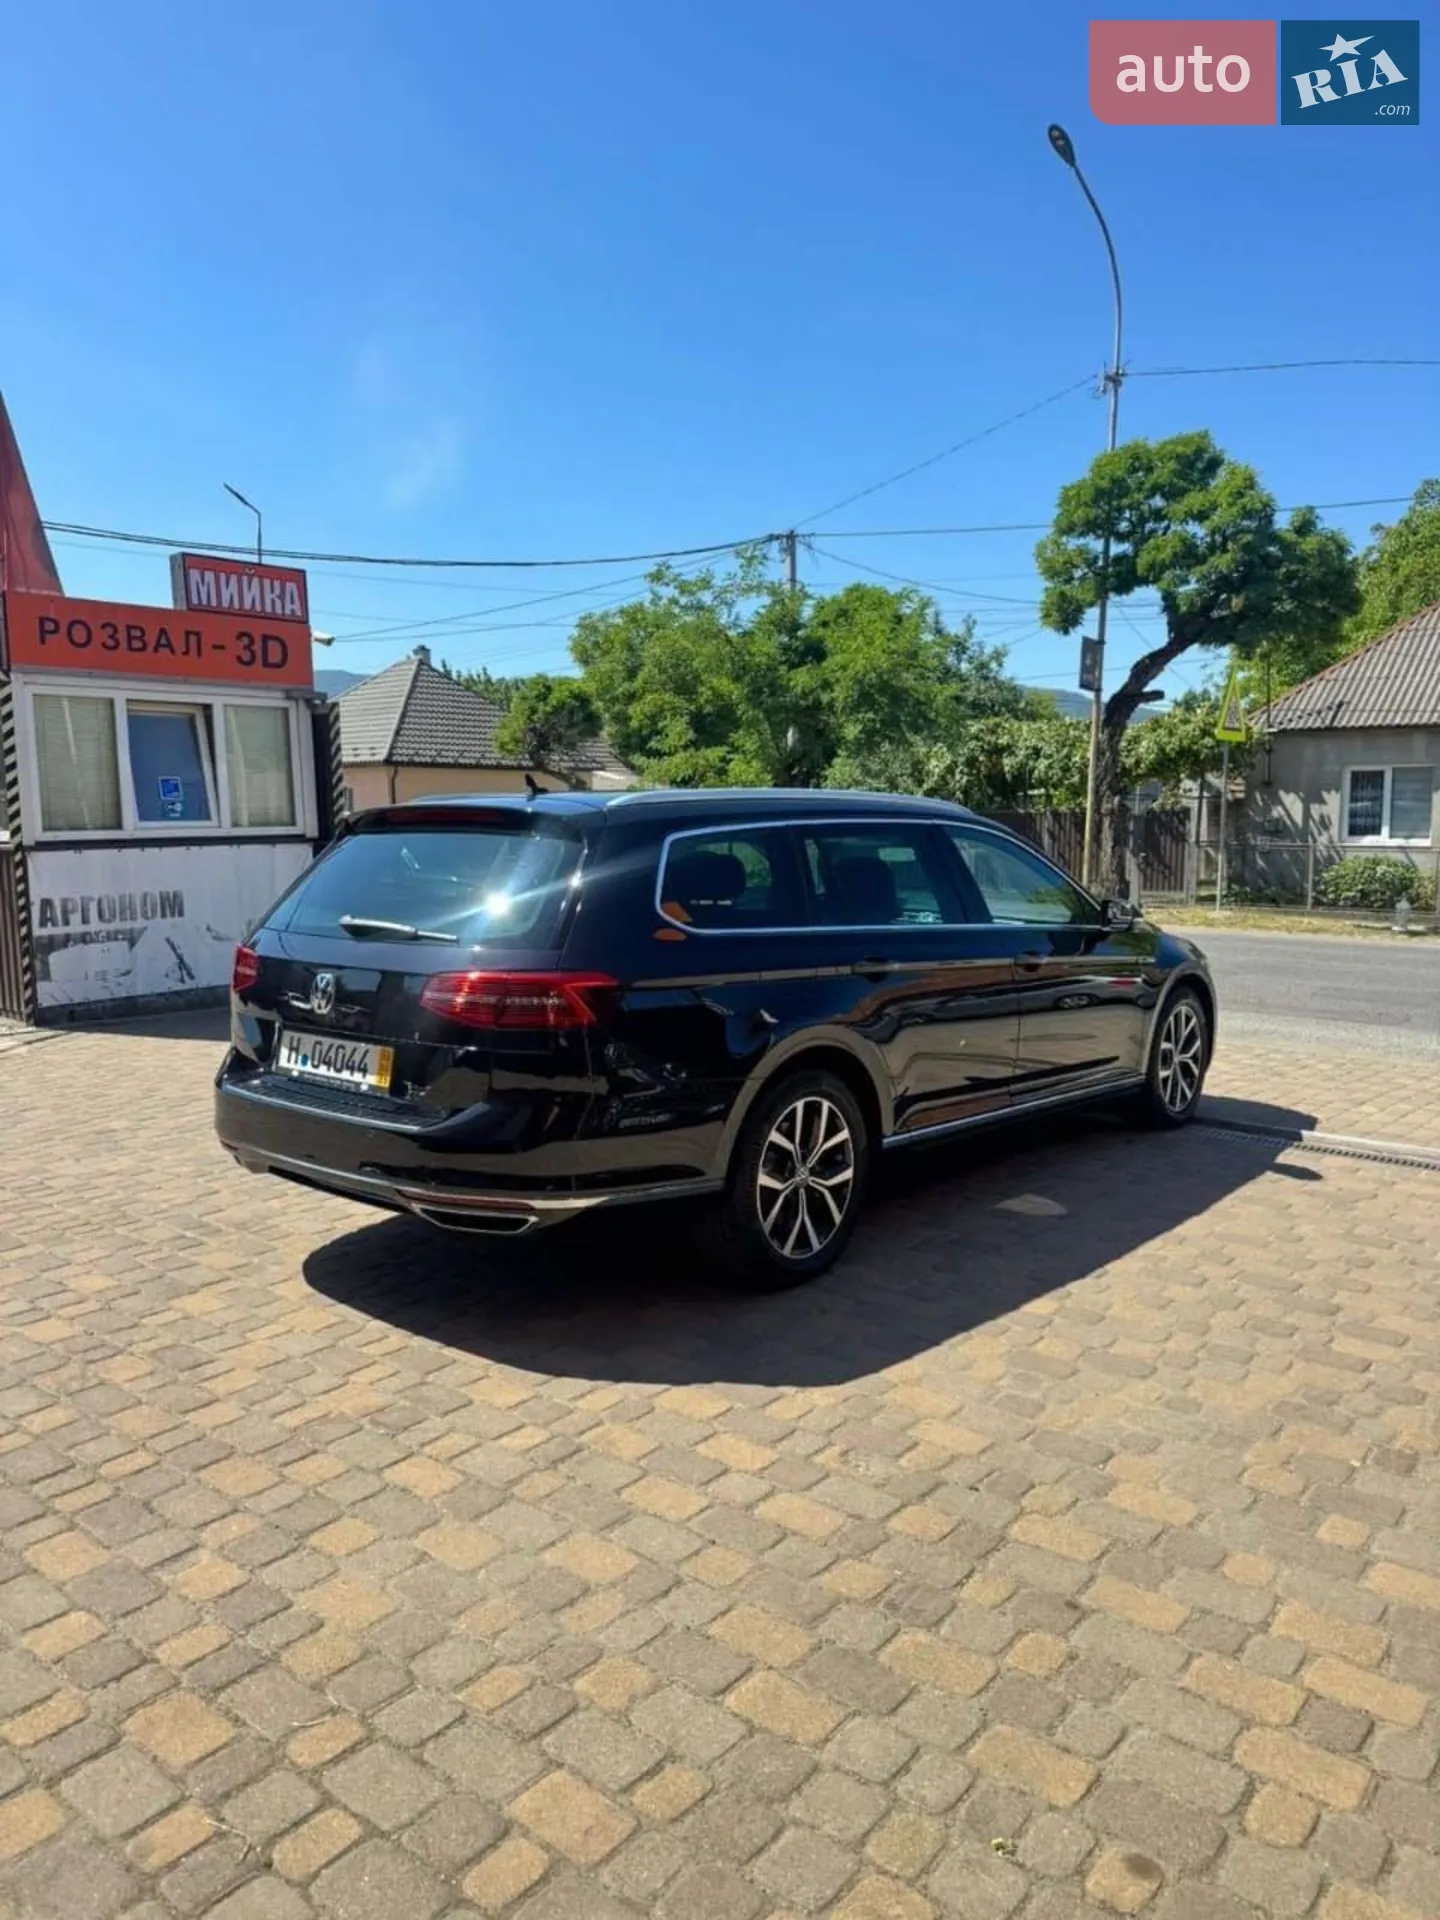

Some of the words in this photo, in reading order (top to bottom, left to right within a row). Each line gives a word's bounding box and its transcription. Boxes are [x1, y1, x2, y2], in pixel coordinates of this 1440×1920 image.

[188, 567, 302, 618] МИЙКА
[39, 889, 185, 928] АРГОНОМ
[310, 1040, 369, 1079] 04044
